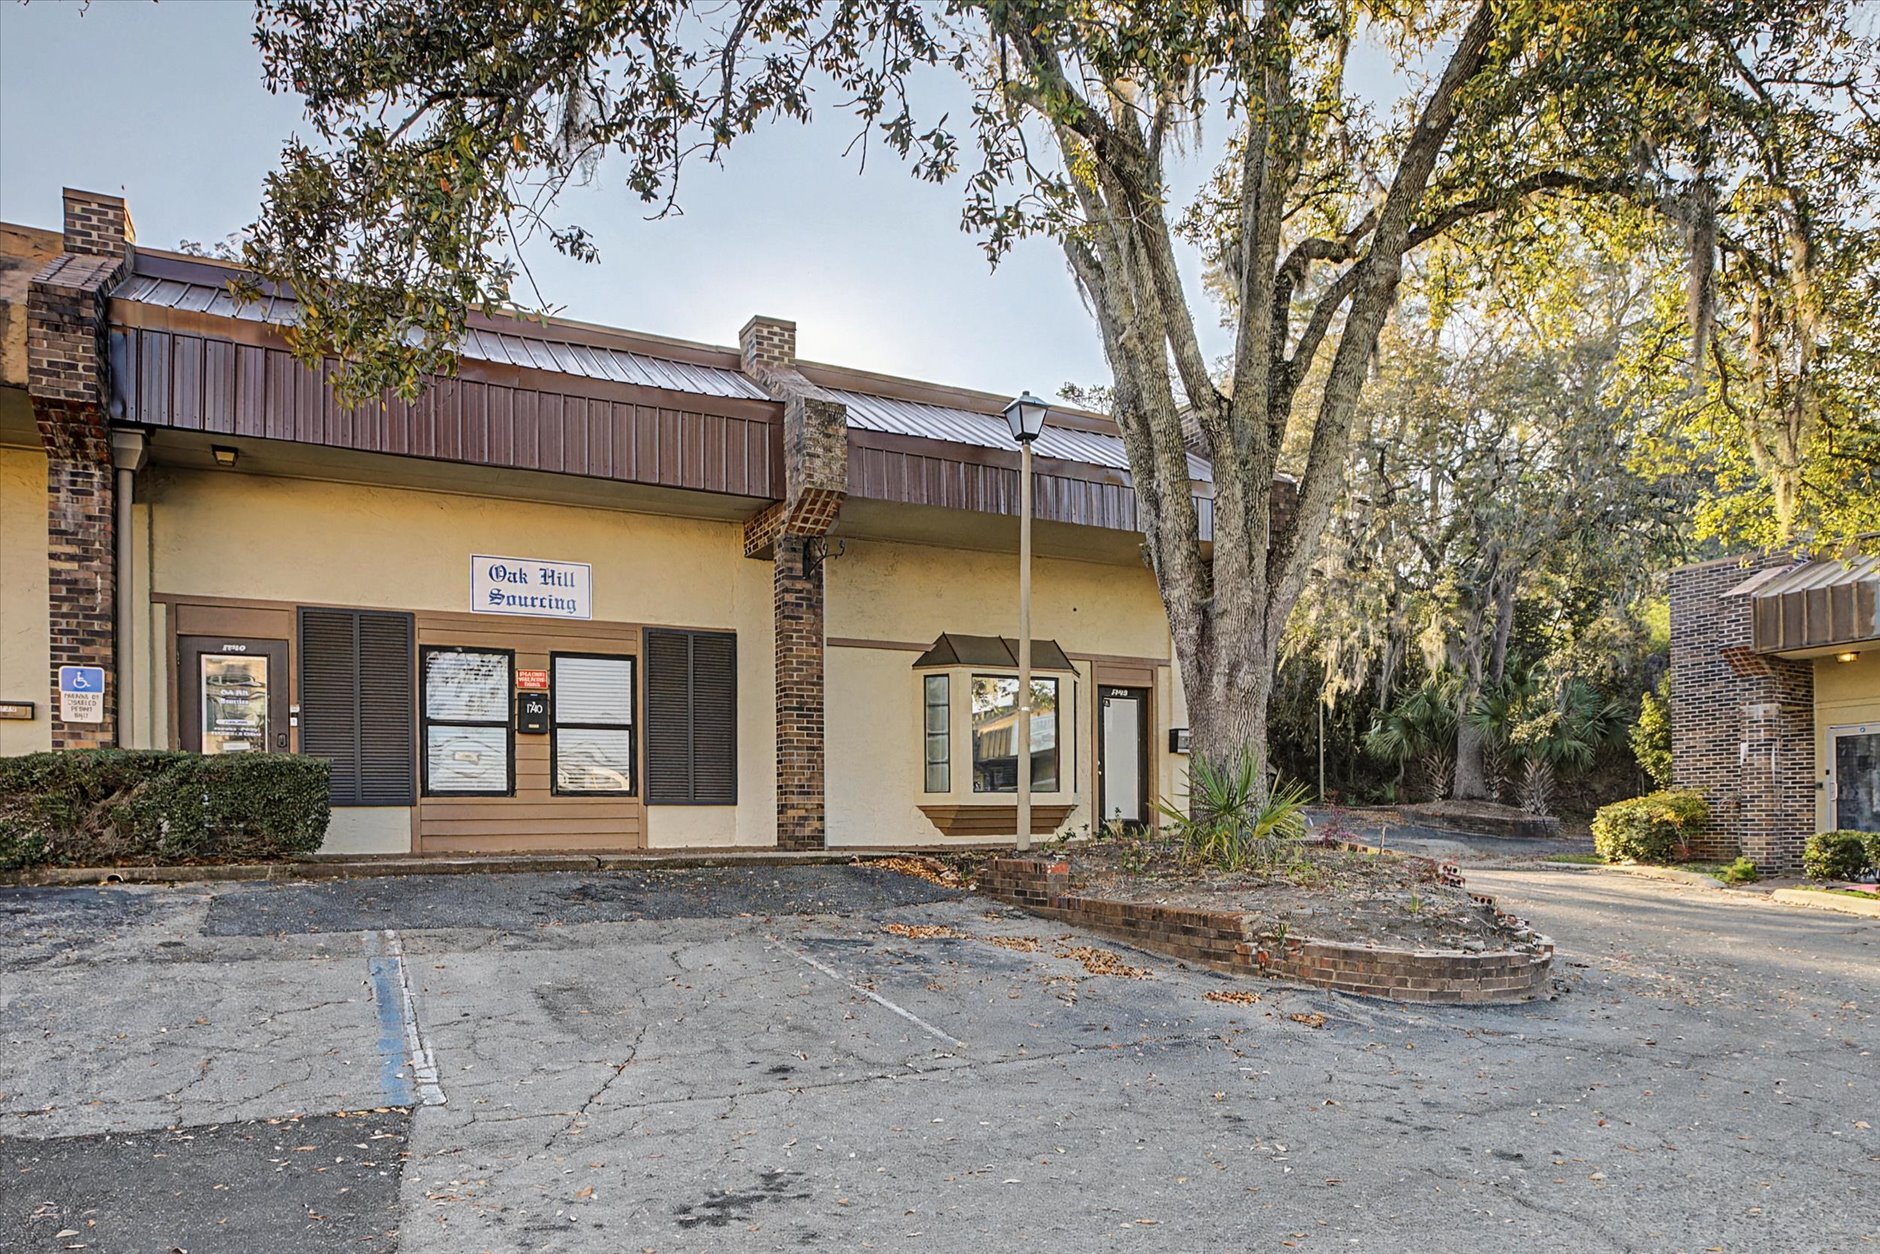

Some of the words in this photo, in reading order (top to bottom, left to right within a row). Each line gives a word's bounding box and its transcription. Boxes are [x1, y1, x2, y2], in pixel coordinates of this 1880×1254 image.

[488, 563, 528, 584] Oak
[539, 568, 576, 588] Hill
[488, 587, 577, 614] Sourcing
